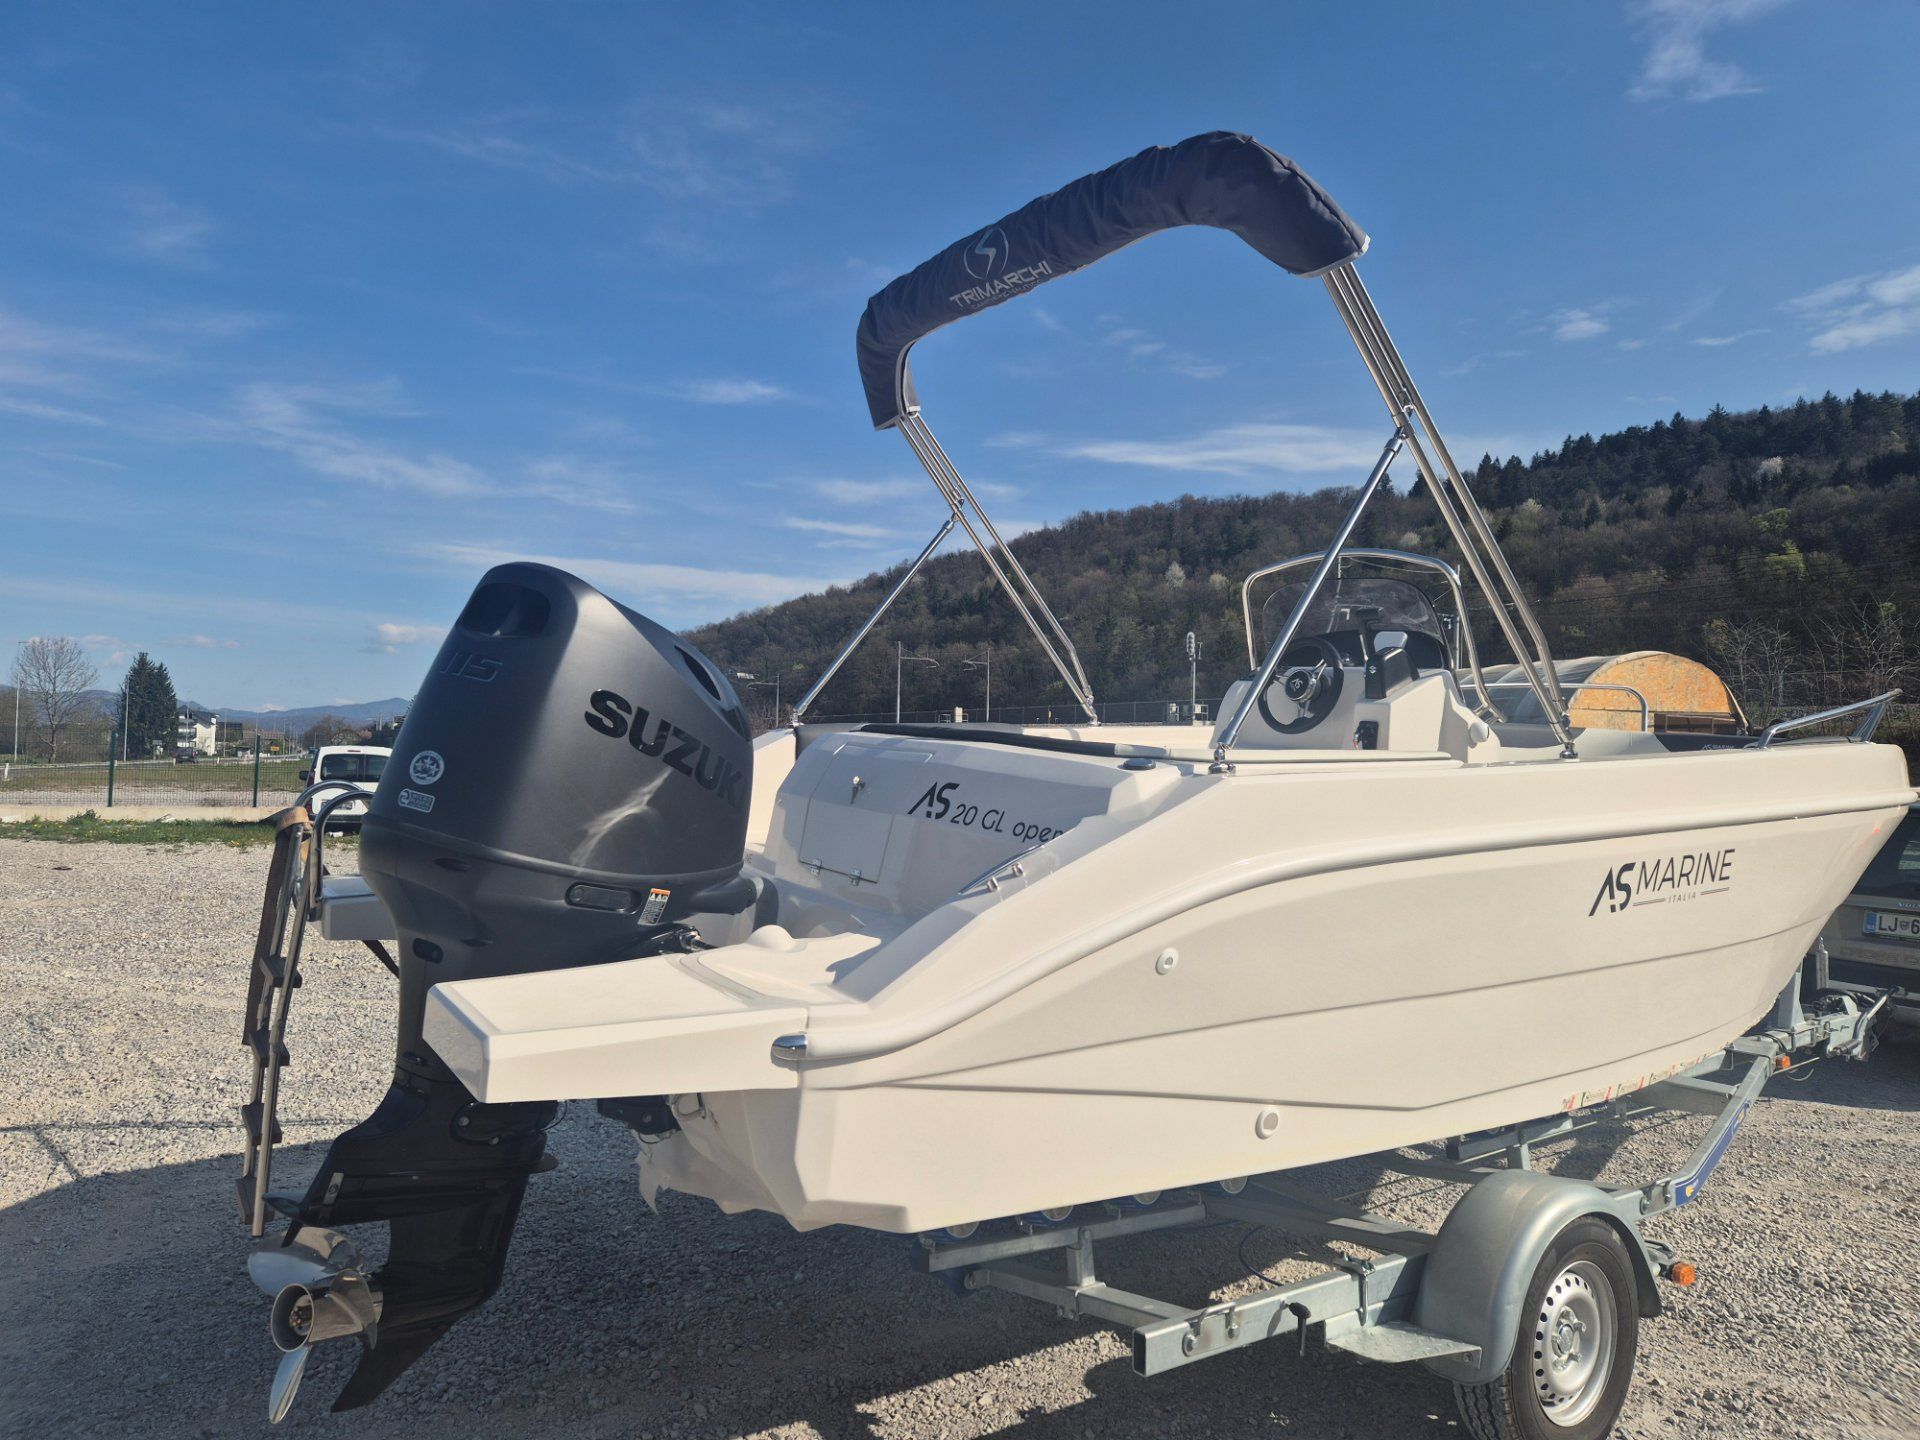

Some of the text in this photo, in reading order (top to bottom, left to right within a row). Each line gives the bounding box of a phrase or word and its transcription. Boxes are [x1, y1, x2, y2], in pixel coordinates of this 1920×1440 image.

[949, 260, 1052, 308] TRIMARCHI
[440, 652, 503, 682] 115
[907, 781, 960, 820] AS
[950, 803, 978, 826] 20
[981, 808, 1005, 833] GL
[1636, 848, 1735, 895] MARINE
[1668, 891, 1696, 903] ITALIA
[1878, 915, 1898, 932] LJ
